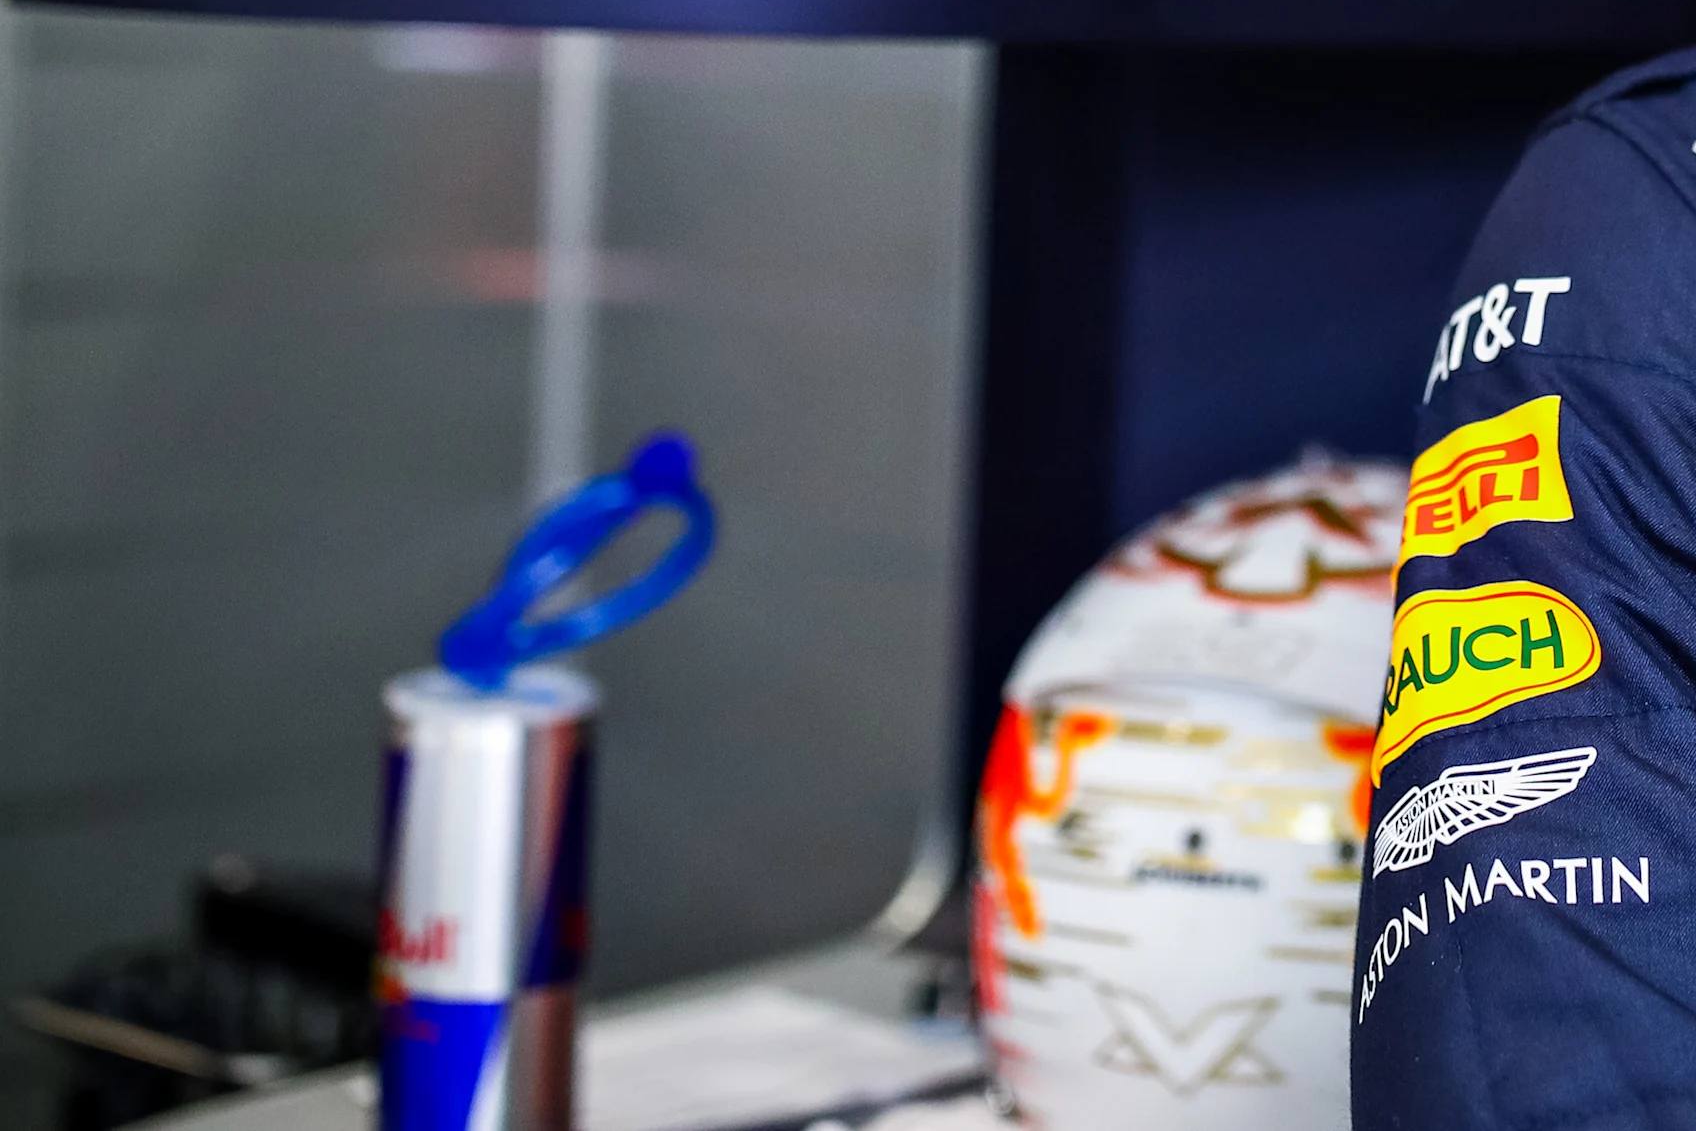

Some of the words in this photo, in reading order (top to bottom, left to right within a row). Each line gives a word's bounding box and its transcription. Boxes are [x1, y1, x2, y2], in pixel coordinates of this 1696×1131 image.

[1423, 276, 1571, 406] AT&T
[1402, 433, 1540, 545] ELLI
[1358, 893, 1430, 1025] ASTON
[1443, 855, 1651, 925] MARTIN
